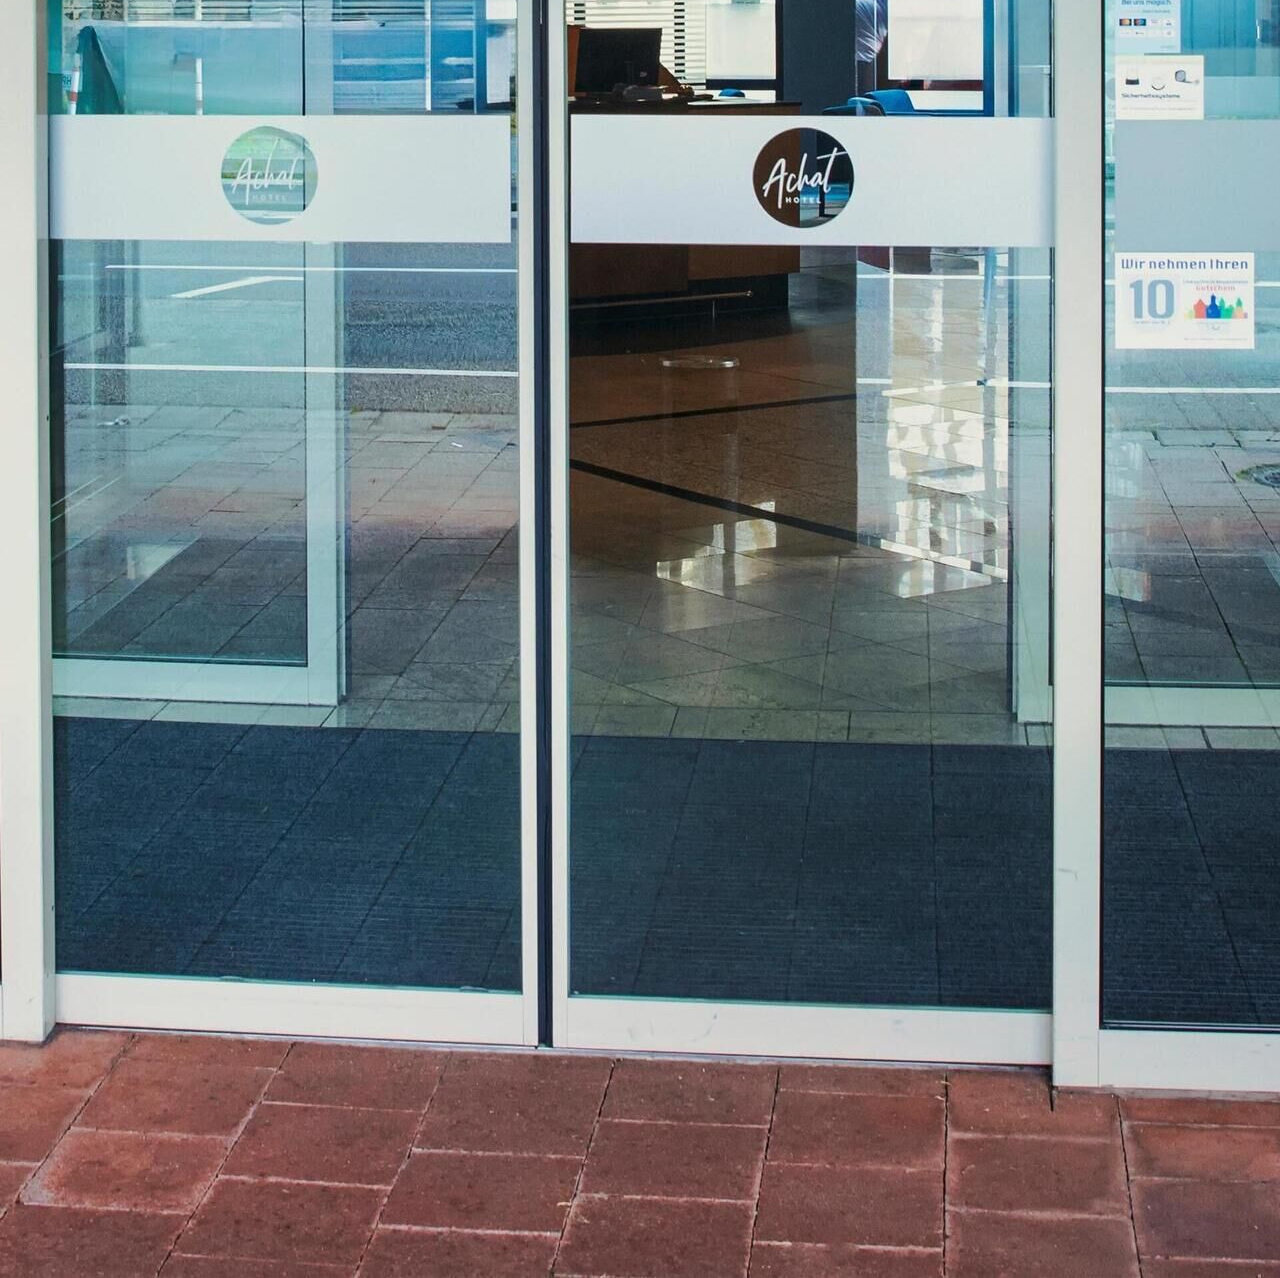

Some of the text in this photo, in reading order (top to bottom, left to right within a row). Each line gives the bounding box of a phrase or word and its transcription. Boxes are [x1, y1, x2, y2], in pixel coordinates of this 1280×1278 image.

[231, 136, 302, 206] Achat
[762, 146, 848, 209] Achat
[252, 193, 288, 202] HOTEL
[785, 196, 821, 204] HOTEL
[1121, 258, 1249, 270] Wir nehmen Ihren
[1128, 279, 1175, 319] 10
